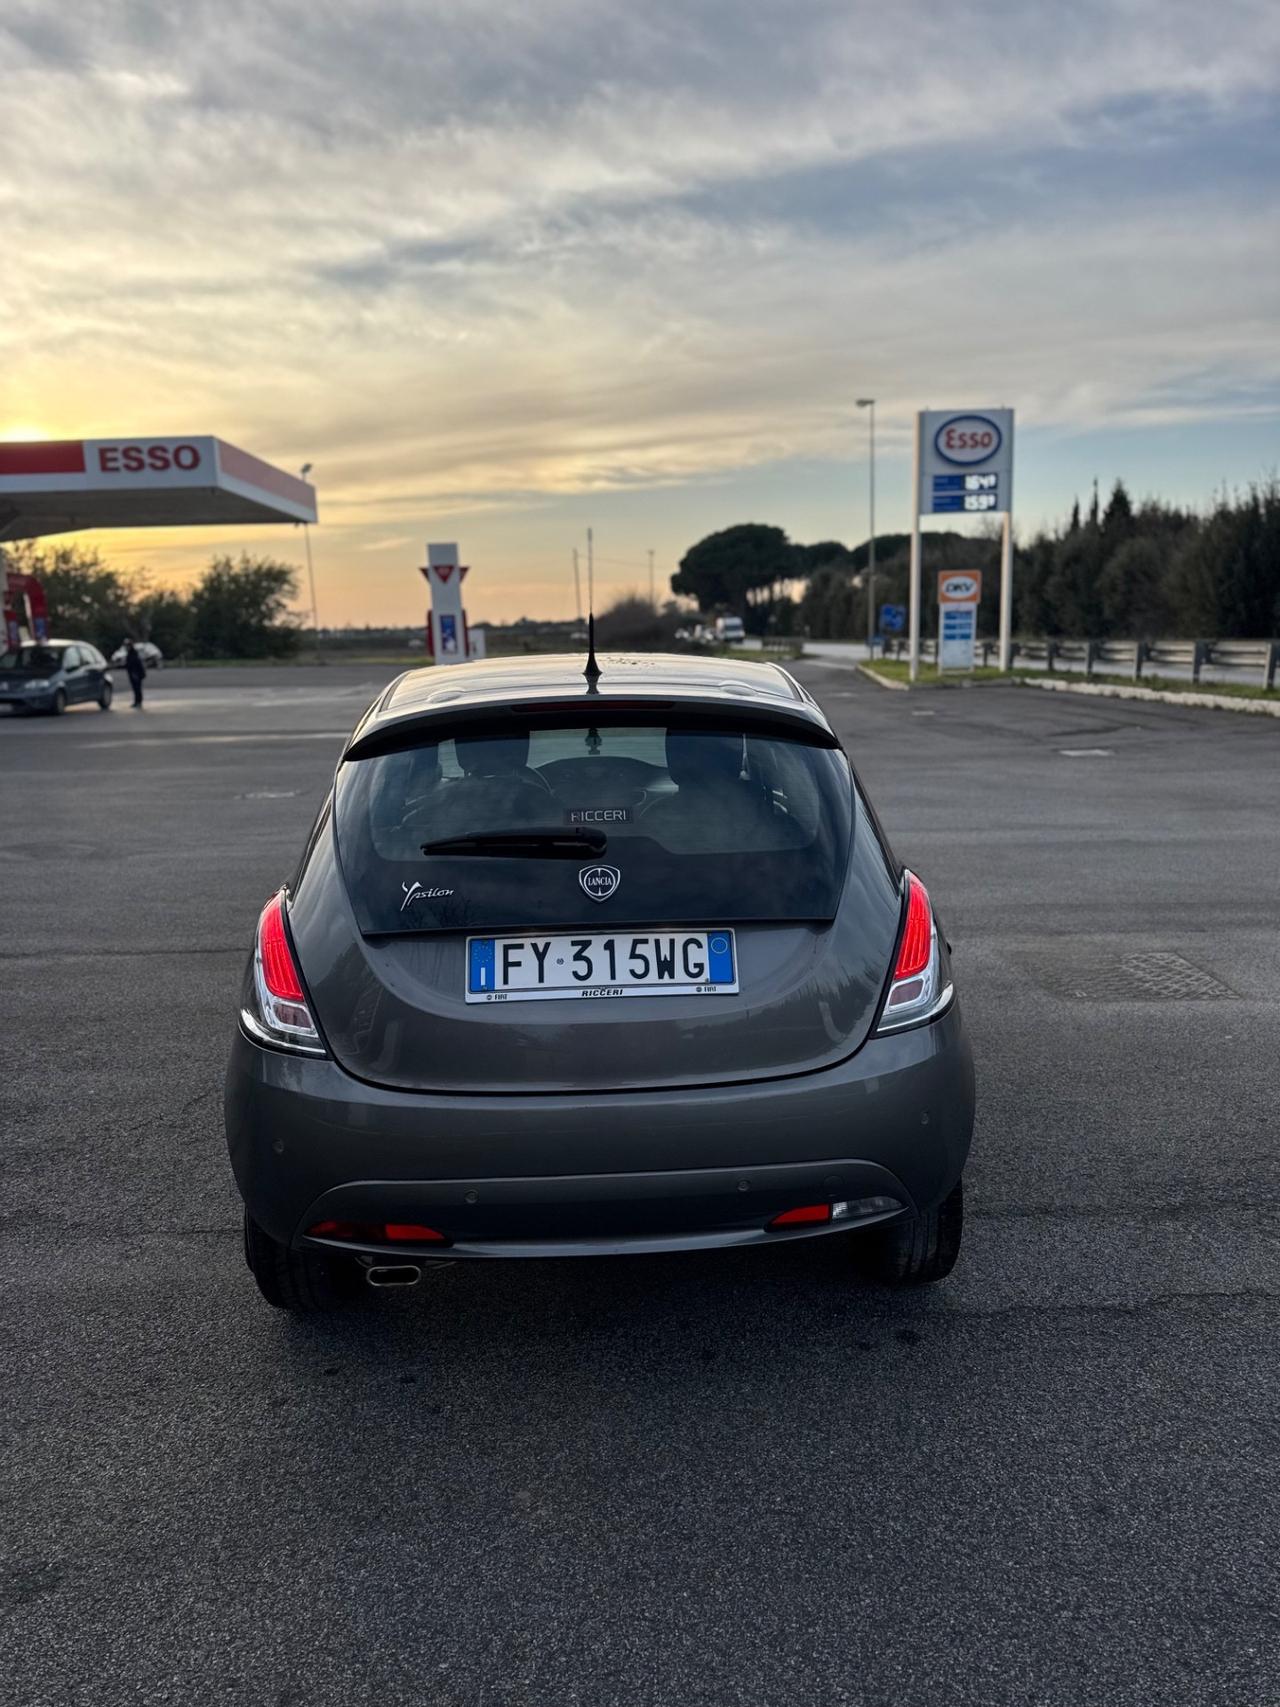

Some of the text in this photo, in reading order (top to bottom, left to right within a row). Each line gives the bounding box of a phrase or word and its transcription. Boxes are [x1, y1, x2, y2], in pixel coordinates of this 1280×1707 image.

[945, 428, 993, 449] Esso
[98, 444, 201, 473] ESSO
[587, 876, 613, 886] LANCIA
[400, 881, 455, 911] Ypsilon
[502, 941, 551, 985] FY
[570, 937, 705, 982] 315WG
[582, 989, 624, 997] RICCERI
